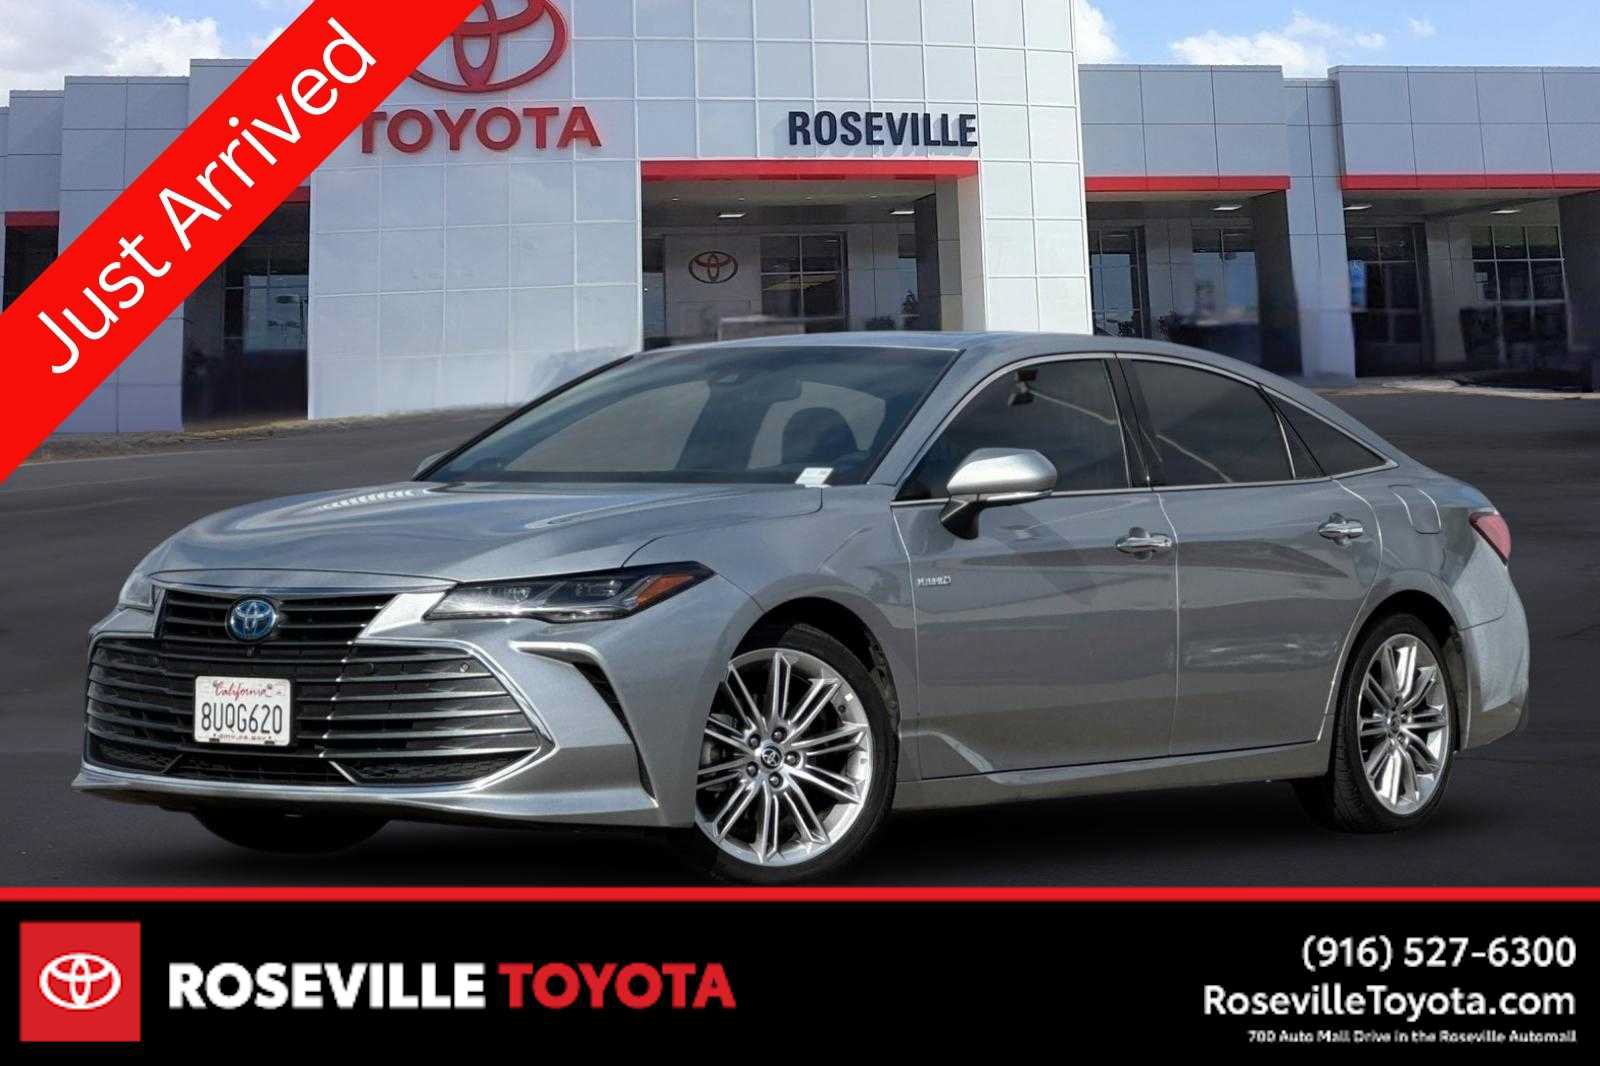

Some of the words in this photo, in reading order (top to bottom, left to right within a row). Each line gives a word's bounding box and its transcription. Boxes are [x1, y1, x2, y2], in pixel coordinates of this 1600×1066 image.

[361, 106, 602, 154] TOYOTA
[788, 110, 978, 147] ROSEVILLE
[215, 680, 267, 701] California
[201, 702, 283, 735] 8UQG620
